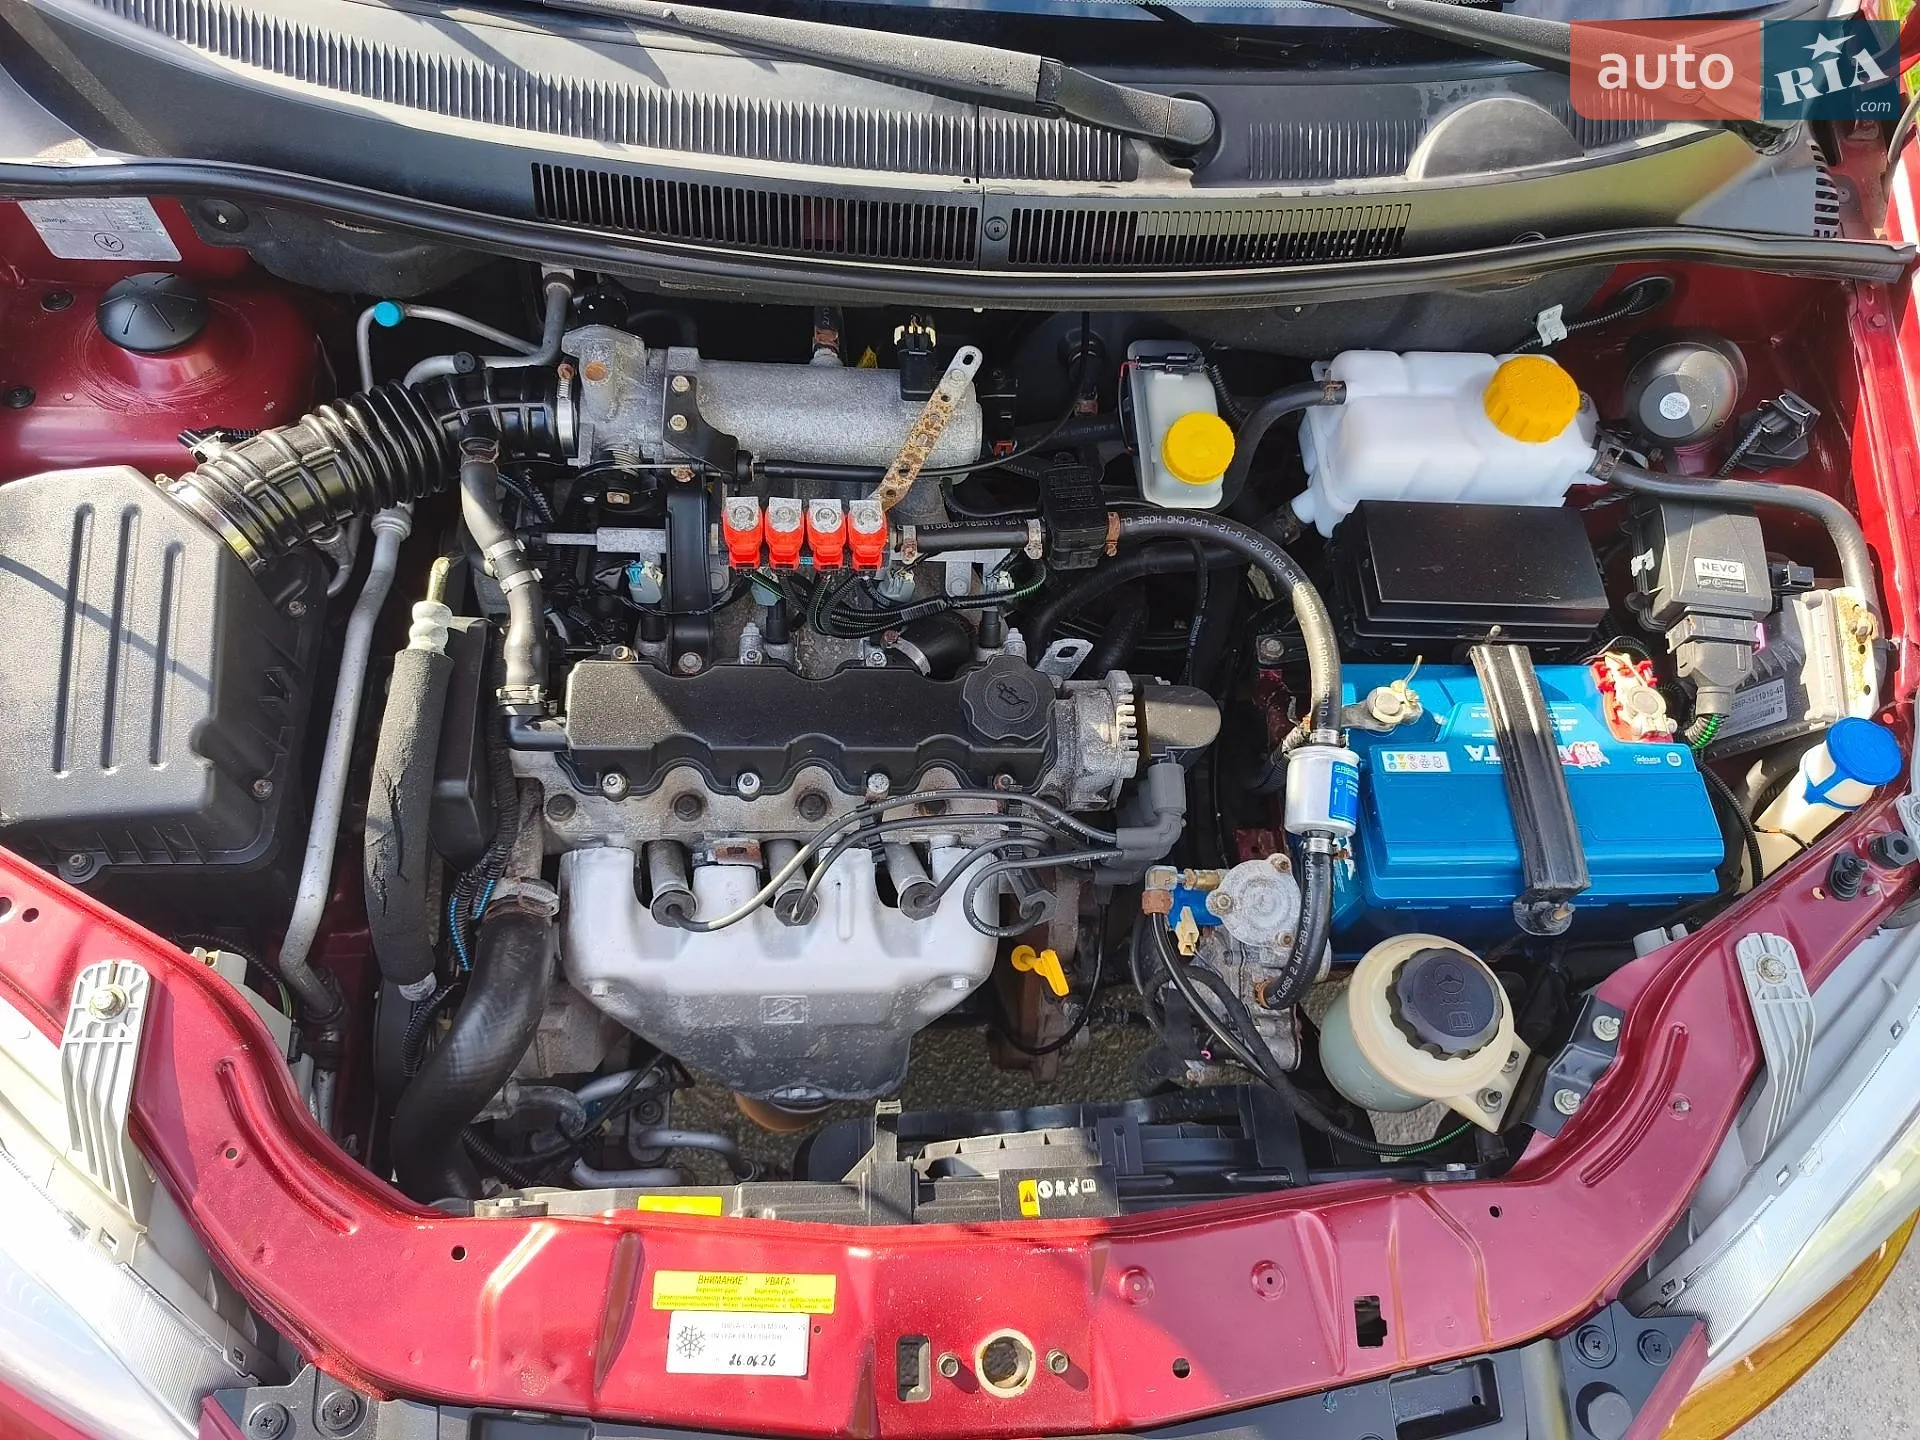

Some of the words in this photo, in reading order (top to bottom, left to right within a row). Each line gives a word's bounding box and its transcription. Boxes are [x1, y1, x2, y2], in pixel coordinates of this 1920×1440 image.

[1138, 515, 1162, 525] HOSE
[1167, 515, 1209, 529] LPG/CNG
[1701, 561, 1737, 574] NEVO
[1277, 976, 1294, 999] CLASS
[1288, 965, 1298, 976] 2
